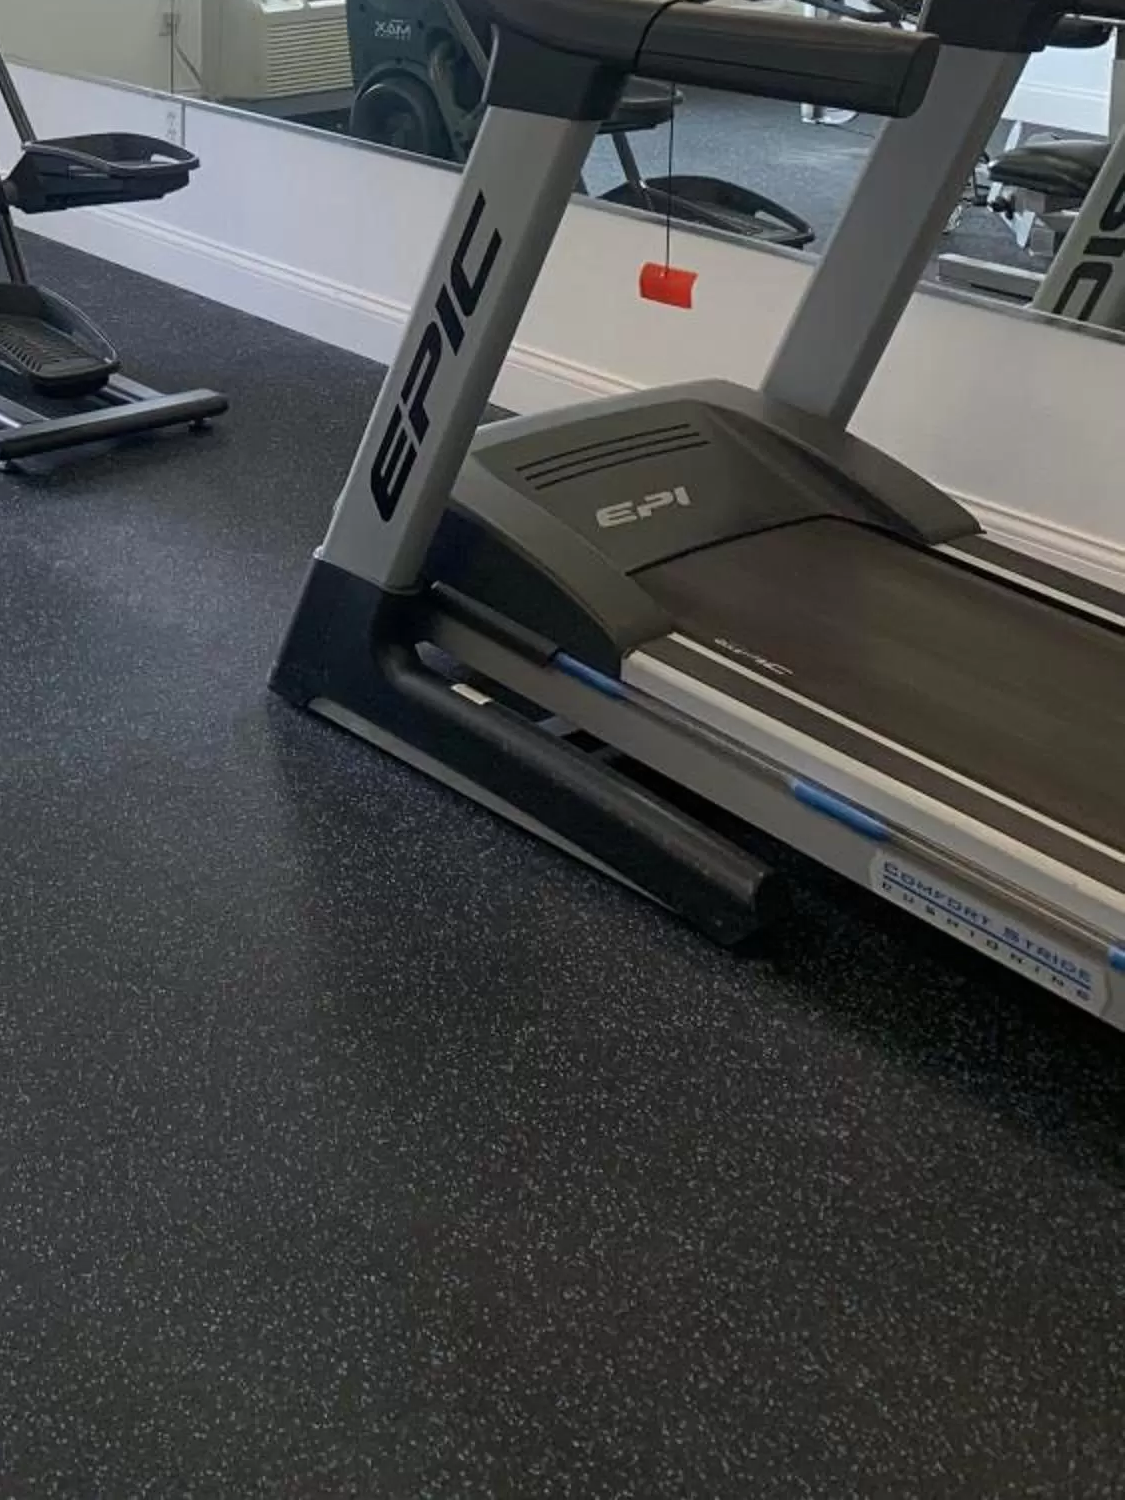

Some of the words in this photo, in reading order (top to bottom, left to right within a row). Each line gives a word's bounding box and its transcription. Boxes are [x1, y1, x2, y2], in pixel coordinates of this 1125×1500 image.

[370, 188, 502, 522] EPIC
[596, 486, 691, 527] EPI
[883, 862, 991, 925] COMFORT
[1003, 927, 1092, 982] STRIDE
